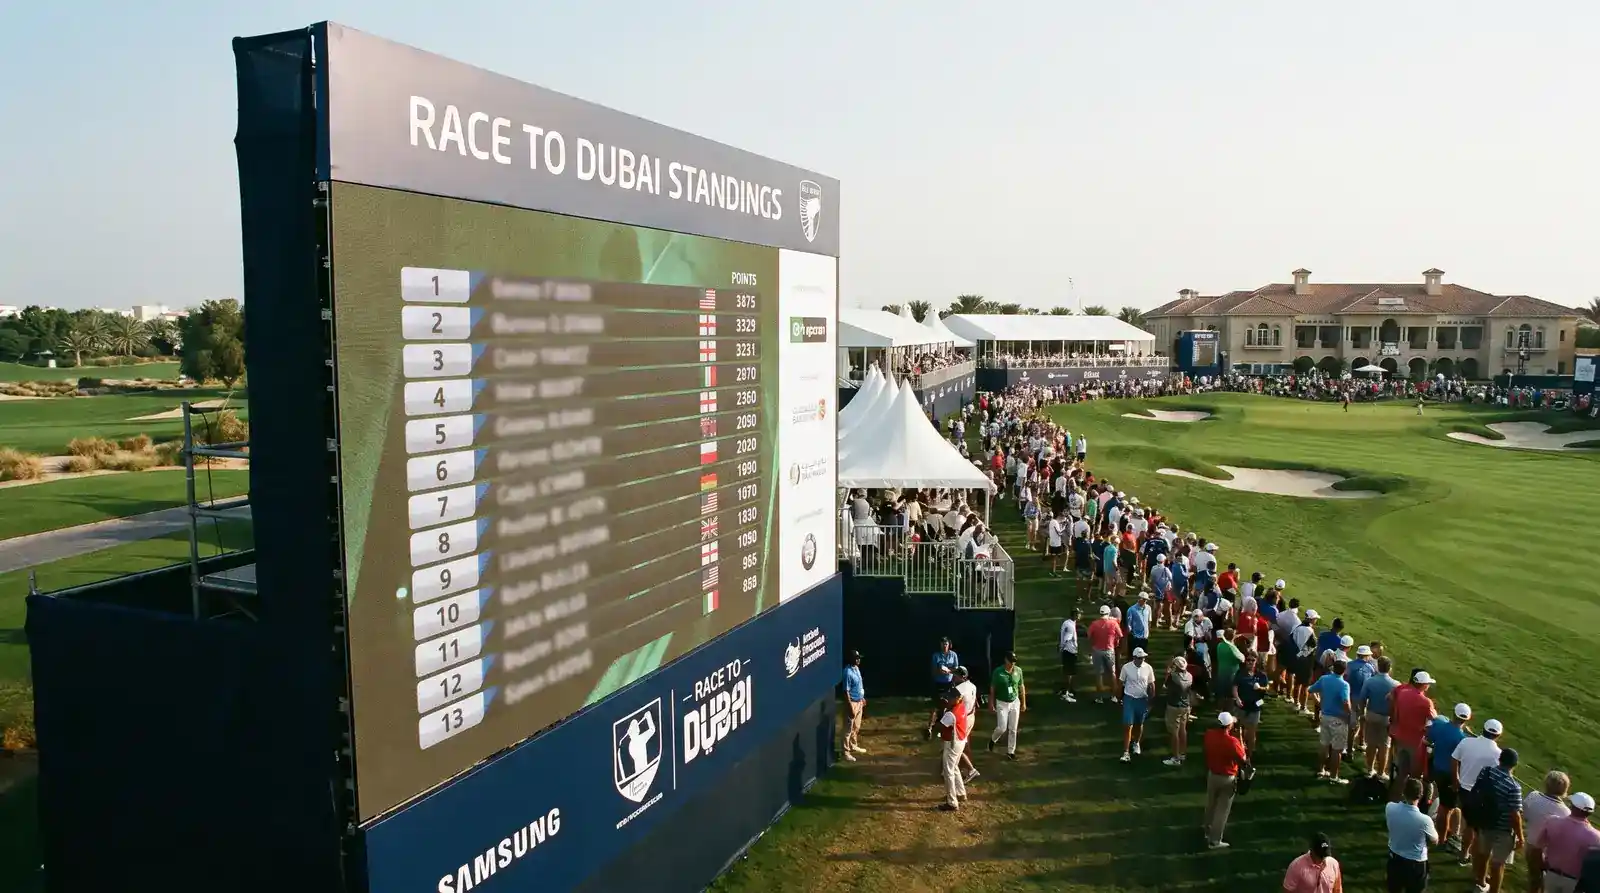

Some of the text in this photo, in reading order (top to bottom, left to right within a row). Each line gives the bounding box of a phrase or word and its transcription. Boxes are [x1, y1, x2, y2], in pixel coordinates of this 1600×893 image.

[408, 95, 784, 222] RACE TO DUBAI STANDINGS
[431, 275, 440, 296] 1
[731, 271, 757, 286] POINTS
[736, 294, 756, 309] 3875
[431, 312, 443, 334] 2
[736, 318, 756, 333] 3329
[433, 349, 444, 371] 3
[736, 343, 756, 357] 3231
[433, 386, 446, 408] 4
[435, 423, 446, 445] 5
[736, 437, 757, 454] 2020
[436, 460, 448, 481] 6
[437, 495, 449, 517] 7
[737, 507, 757, 525] 1830
[438, 532, 450, 554] 8
[439, 568, 452, 590] 9
[436, 602, 460, 627] 10
[438, 638, 460, 663] 11
[440, 673, 463, 699] 12
[695, 658, 741, 702] RACE TO
[441, 708, 464, 733] 13
[683, 674, 752, 764] DUBAI
[438, 807, 560, 893] SAMSUNG
